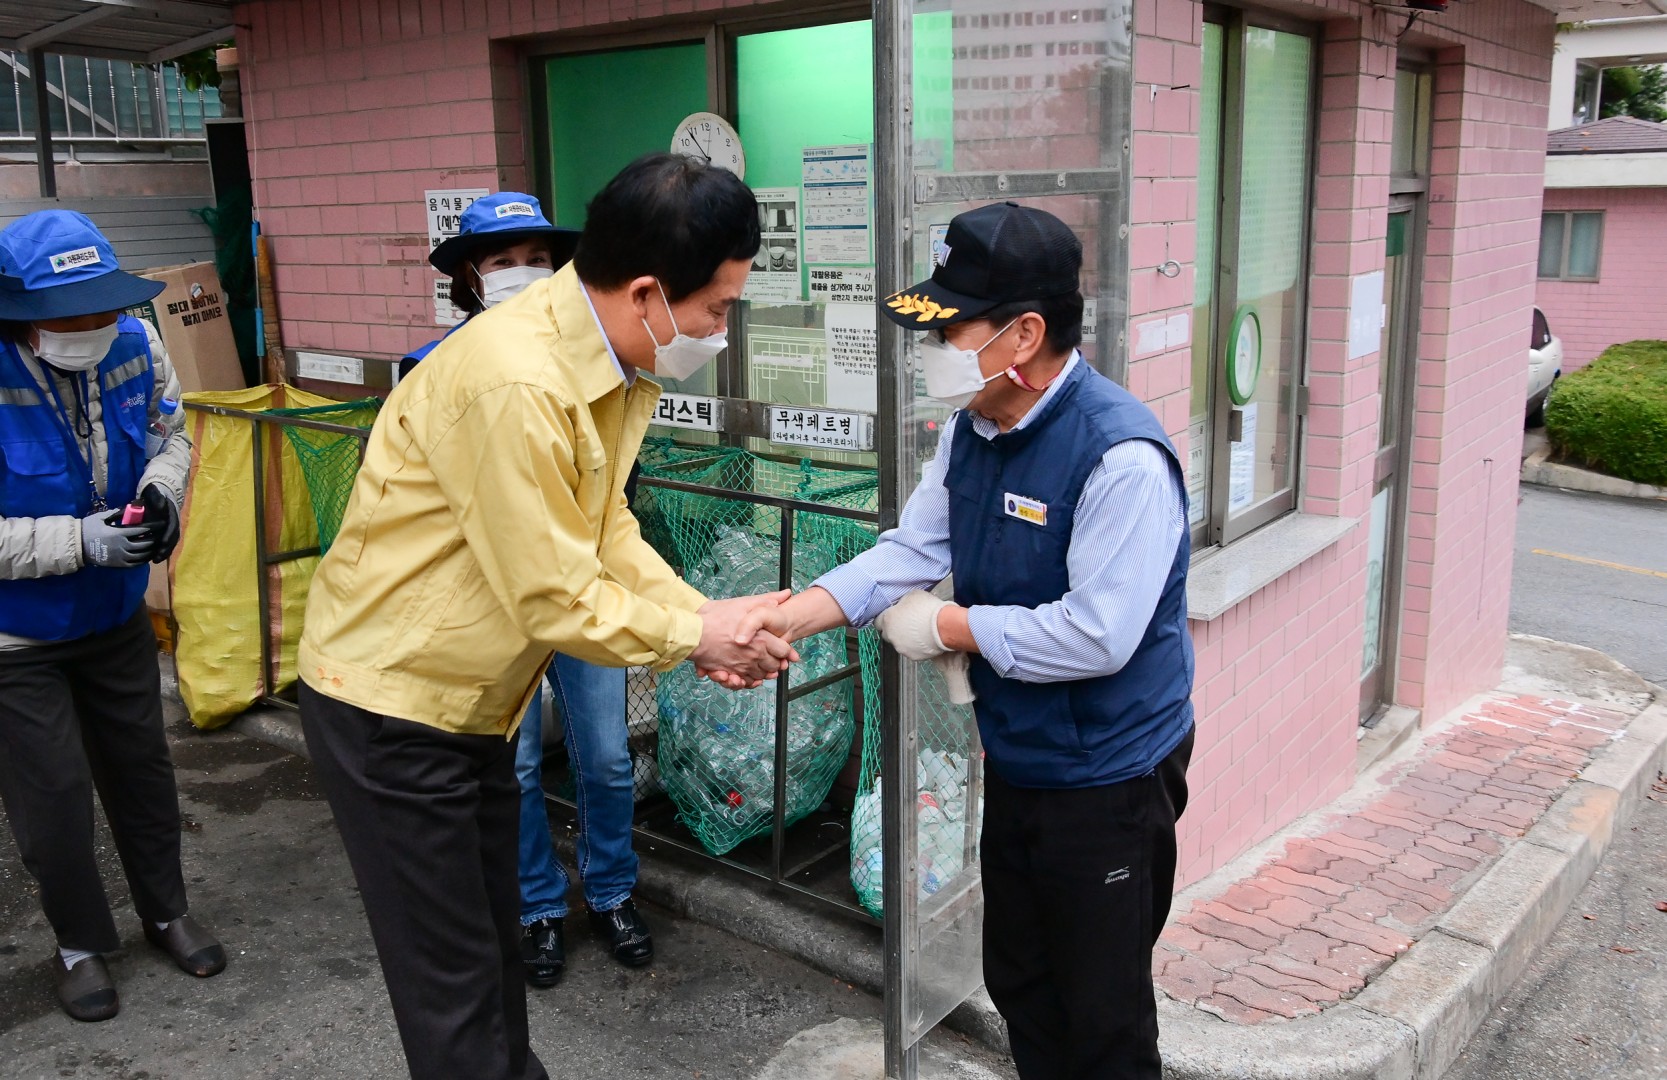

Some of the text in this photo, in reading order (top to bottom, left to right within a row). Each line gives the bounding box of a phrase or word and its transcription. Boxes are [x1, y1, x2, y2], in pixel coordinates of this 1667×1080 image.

[701, 122, 711, 132] 12
[716, 127, 721, 135] 1
[680, 138, 690, 147] 10
[725, 138, 731, 147] 2
[732, 154, 737, 164] 3
[811, 270, 843, 280] 재활용품은
[811, 282, 828, 291] 배출을
[855, 284, 873, 292] 주시기
[167, 300, 190, 315] 절대
[182, 306, 223, 327] 밟지 마시오
[776, 410, 851, 435] 무색페트병
